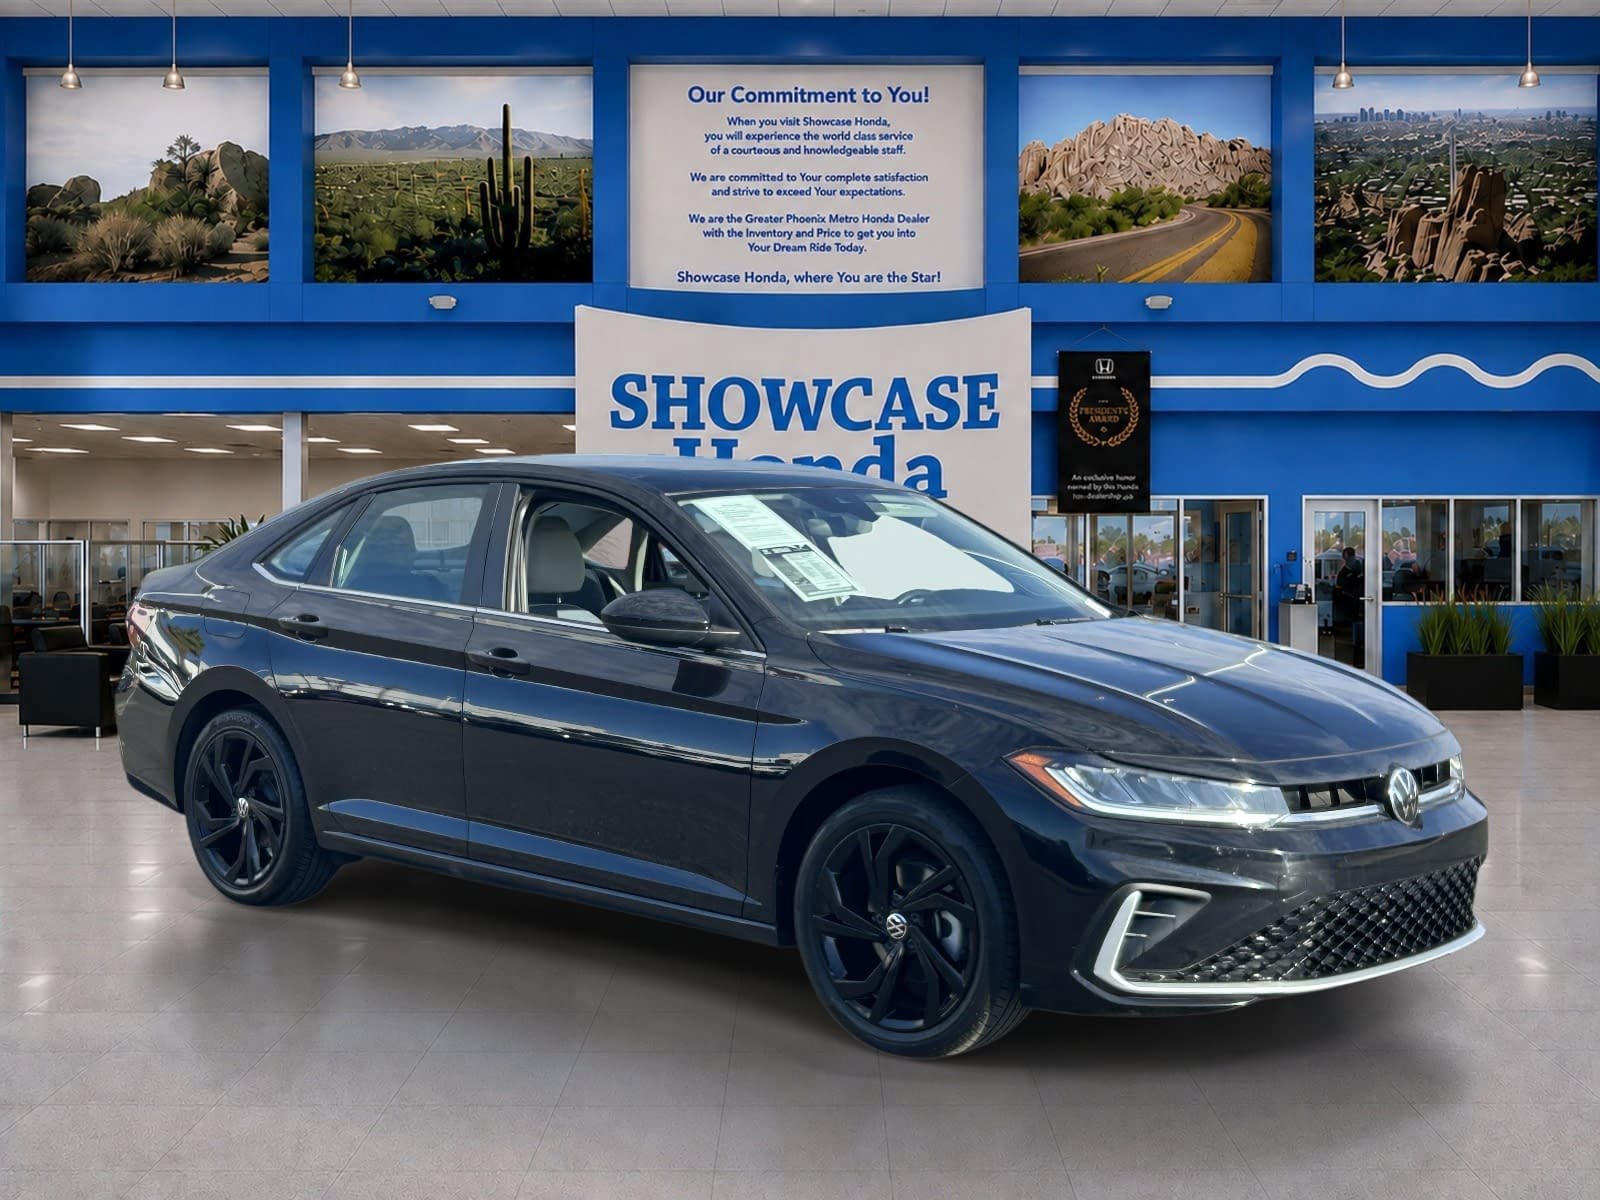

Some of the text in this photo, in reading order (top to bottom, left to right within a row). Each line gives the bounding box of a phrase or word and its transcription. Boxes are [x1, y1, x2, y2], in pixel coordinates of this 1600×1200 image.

[688, 86, 929, 103] Our Commitment to You!
[727, 116, 890, 128] When you visit Showcase Honda,
[705, 131, 913, 143] you will experience the world class service
[710, 145, 721, 154] of
[731, 147, 780, 155] courteous
[783, 145, 801, 154] and
[882, 144, 906, 155] staff.
[690, 172, 707, 182] We
[729, 172, 783, 182] committed
[786, 174, 797, 182] to
[800, 173, 822, 182] Your
[825, 172, 871, 184] complete
[874, 172, 928, 182] satisfaction
[712, 186, 905, 199] and strive to exceed Your expectations.
[689, 214, 705, 223] We
[726, 213, 743, 223] the
[745, 214, 784, 223] Greater
[786, 214, 826, 223] Phoenix
[829, 214, 859, 223] Metro
[862, 214, 894, 223] Honda
[898, 213, 930, 223] Dealer
[703, 228, 916, 240] with the Inventory and Price to get you into
[748, 243, 867, 254] Your Dream Ride Today.
[677, 271, 940, 285] Showcase Honda, where You are the Star!
[610, 373, 1000, 432] SHOWCASE
